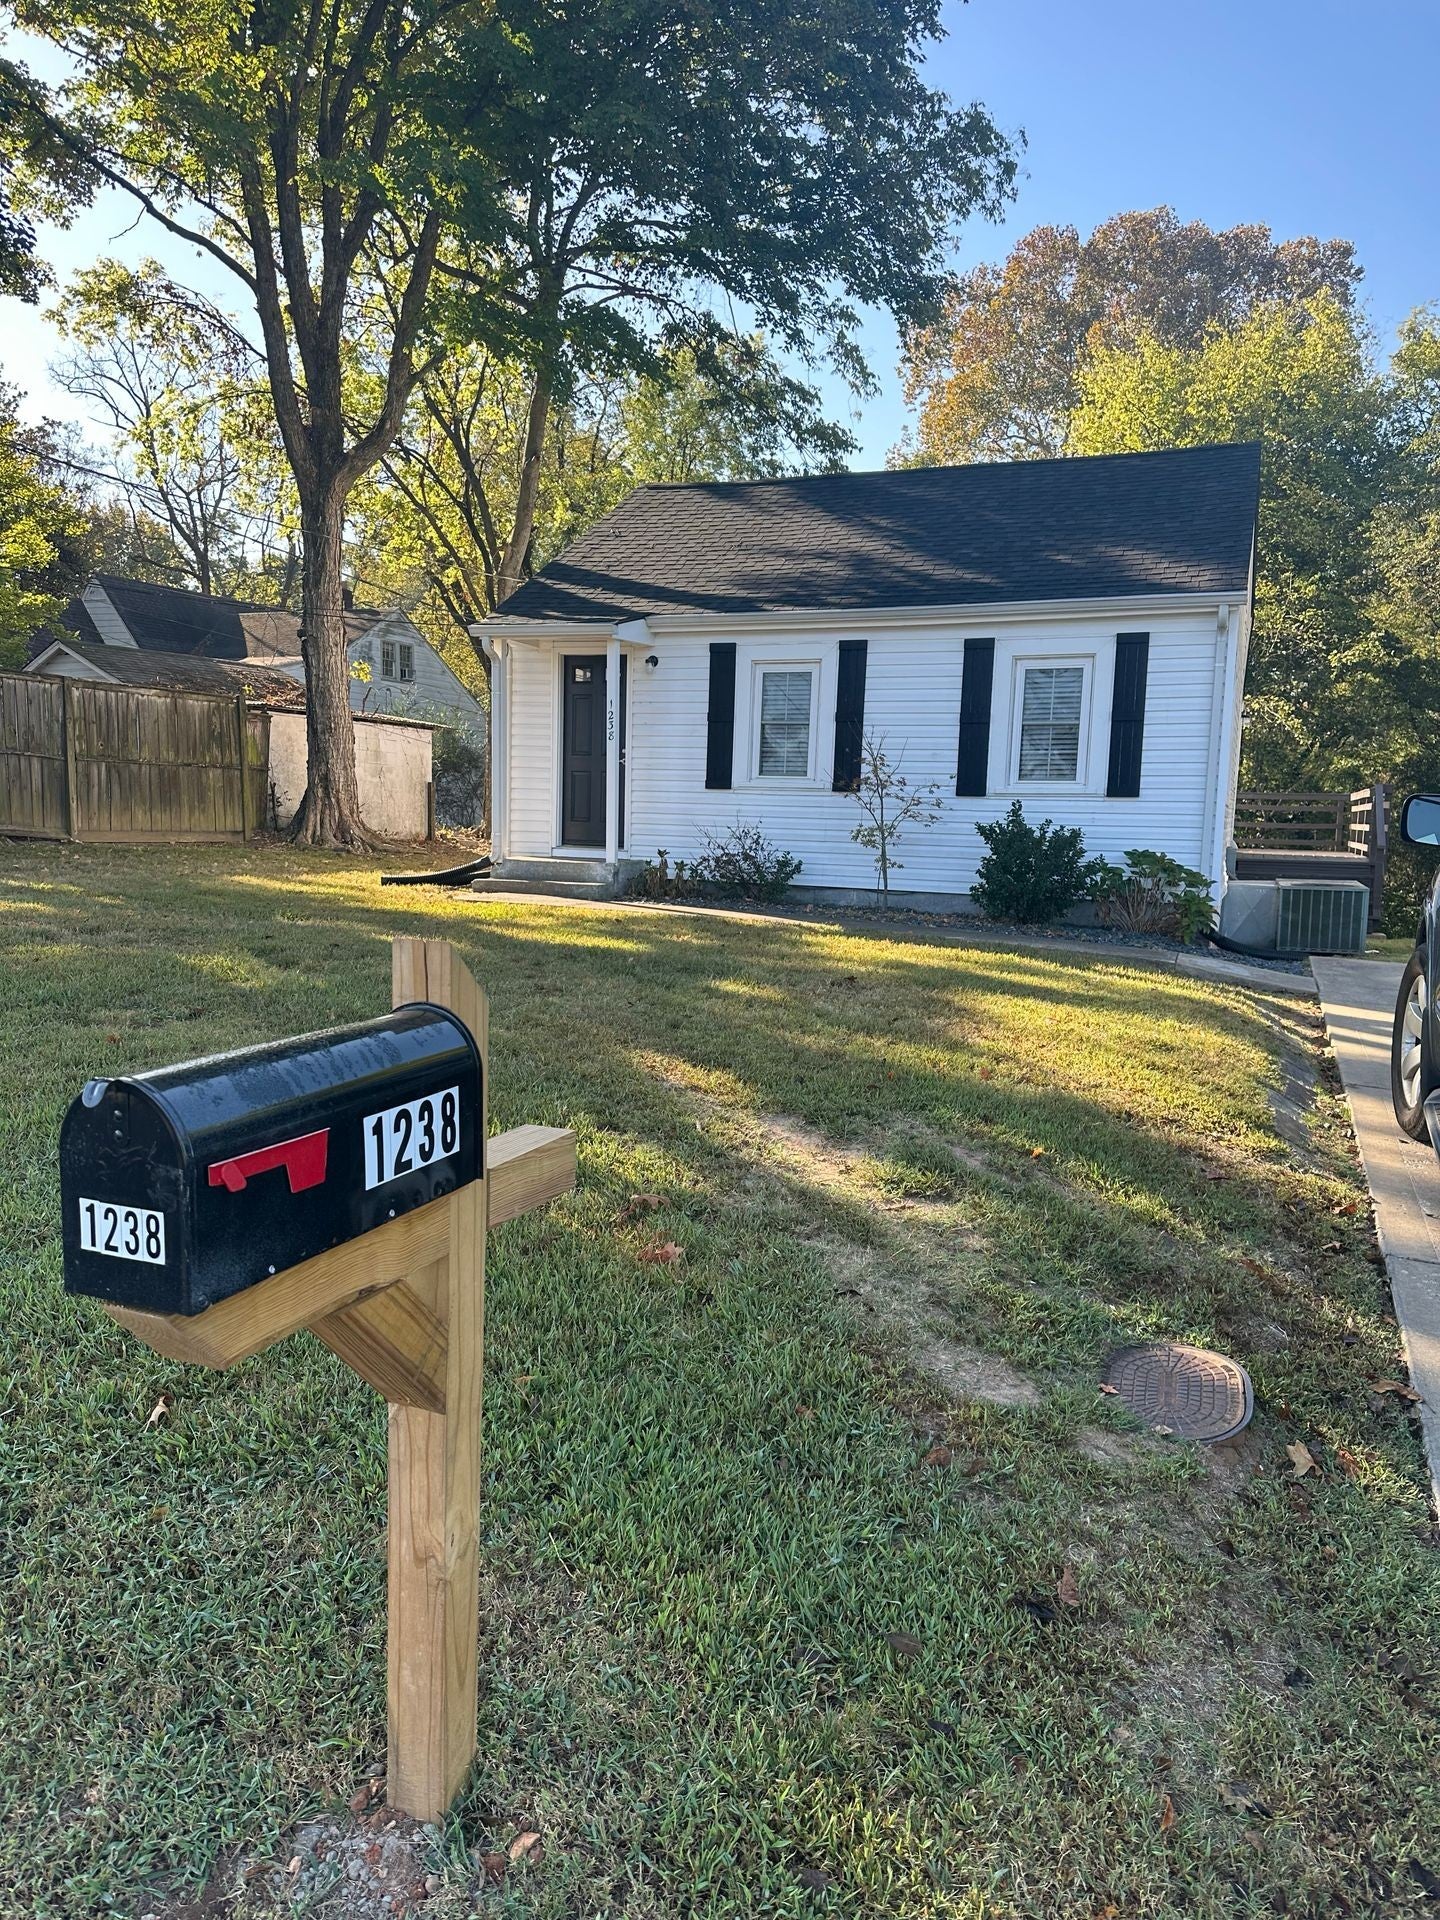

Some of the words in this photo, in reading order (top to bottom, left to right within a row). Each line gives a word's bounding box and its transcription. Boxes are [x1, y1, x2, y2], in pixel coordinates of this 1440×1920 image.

[607, 699, 615, 741] 1238
[372, 1092, 456, 1184] 1238
[85, 1203, 161, 1259] 1238
